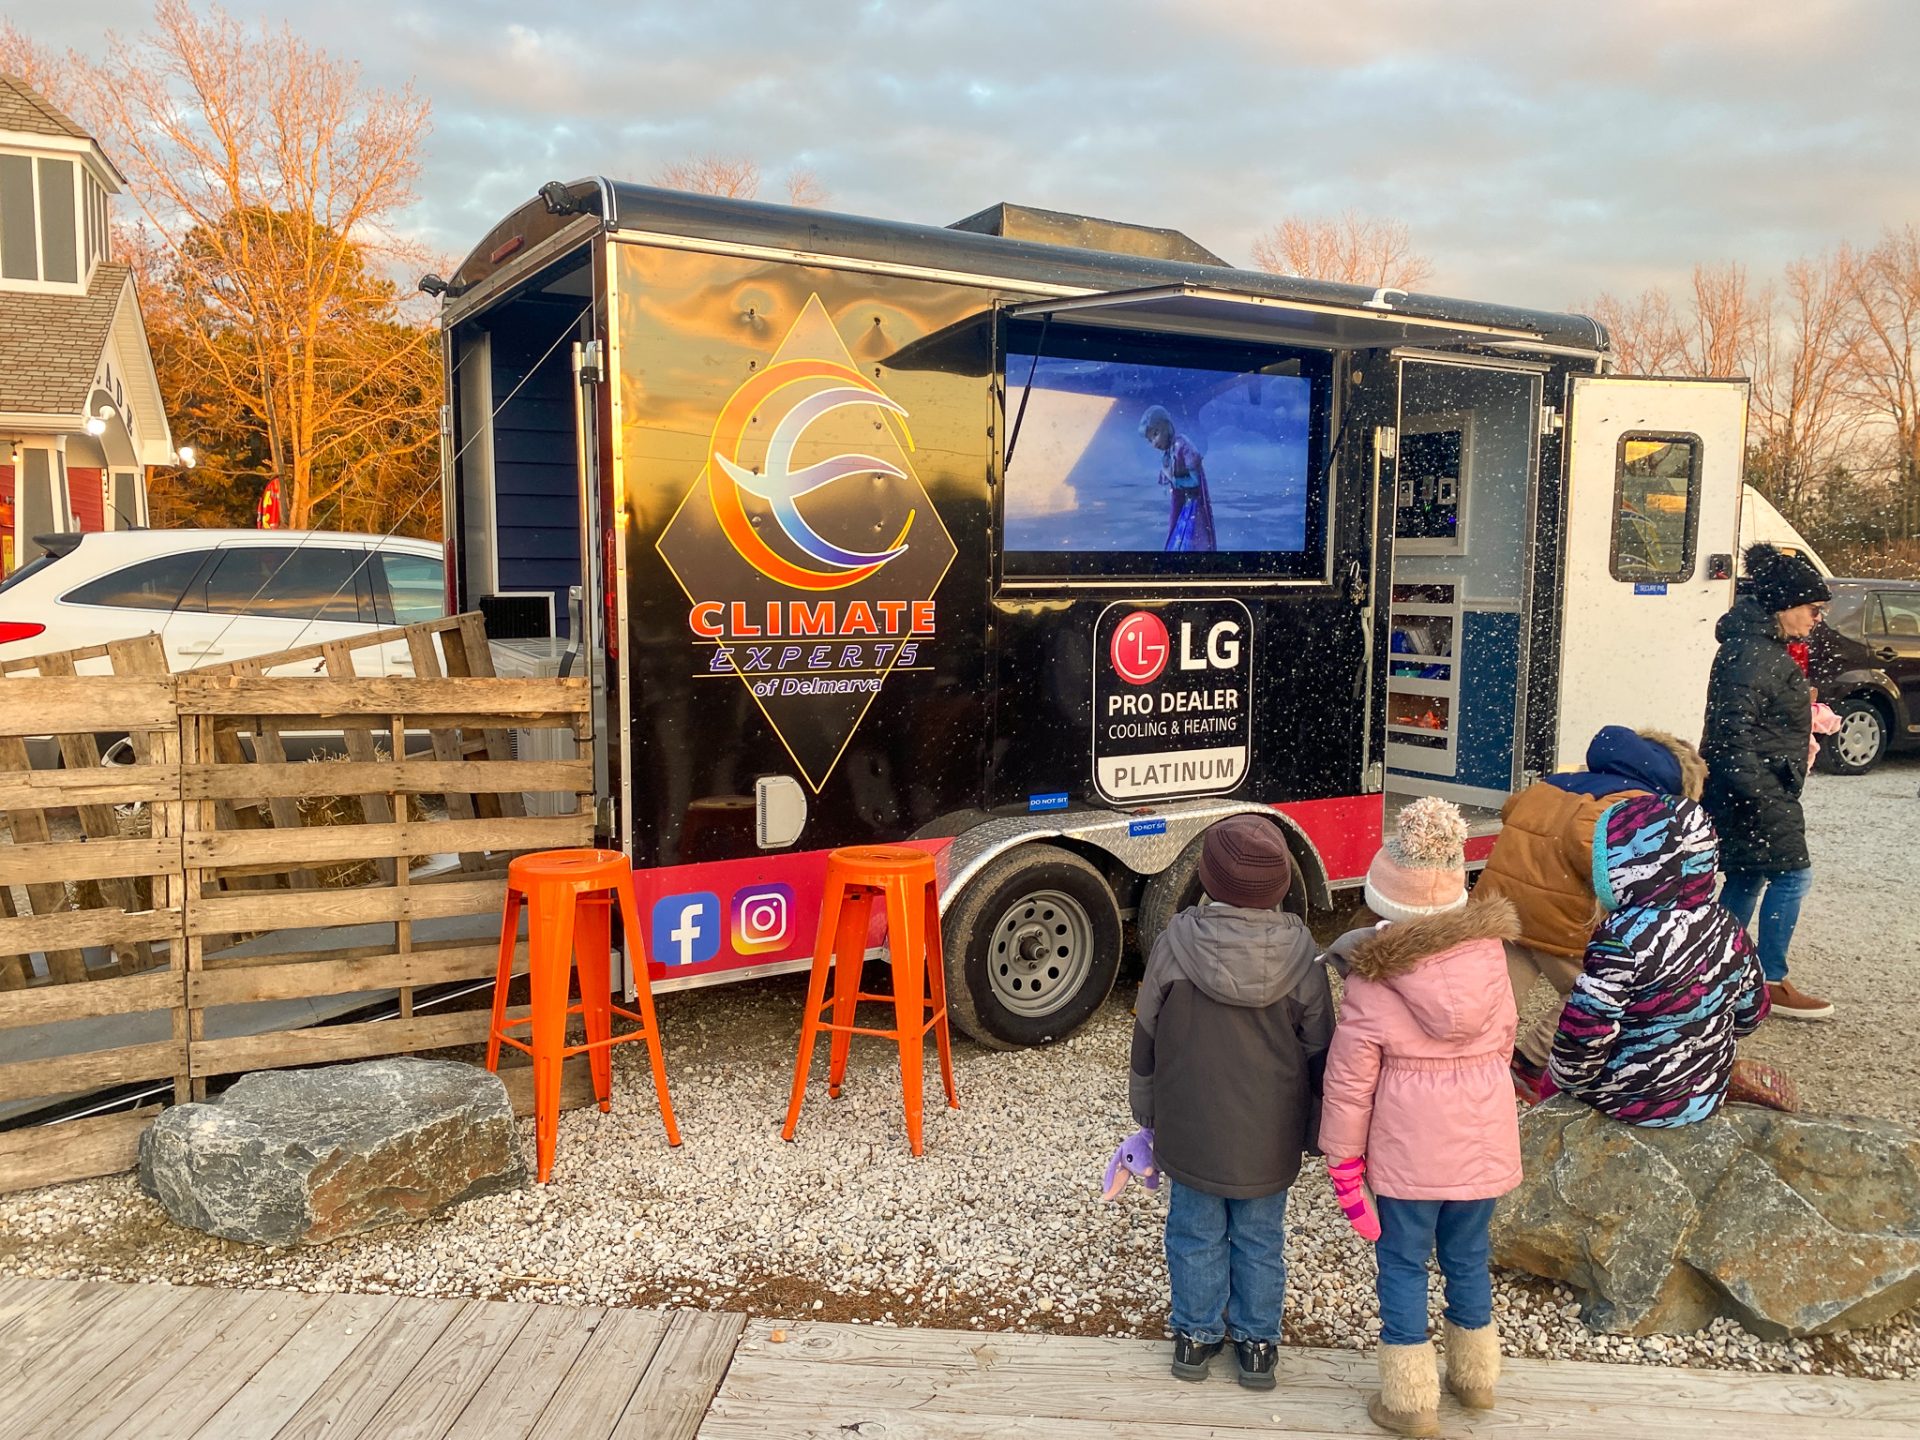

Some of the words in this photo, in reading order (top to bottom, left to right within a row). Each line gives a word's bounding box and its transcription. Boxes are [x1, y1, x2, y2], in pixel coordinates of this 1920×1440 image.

[688, 600, 936, 638] CLIMATE
[709, 643, 919, 672] EXPERTS
[1180, 620, 1240, 671] LG
[752, 678, 779, 698] of
[781, 676, 882, 696] Delmarva
[1108, 693, 1153, 717] PRO
[1160, 689, 1238, 713] DEALER
[1108, 721, 1167, 739] COOLING
[1171, 721, 1180, 735] &
[1184, 717, 1237, 734] HEATING
[1114, 757, 1235, 789] PLATINUM
[1143, 823, 1155, 831] NOT
